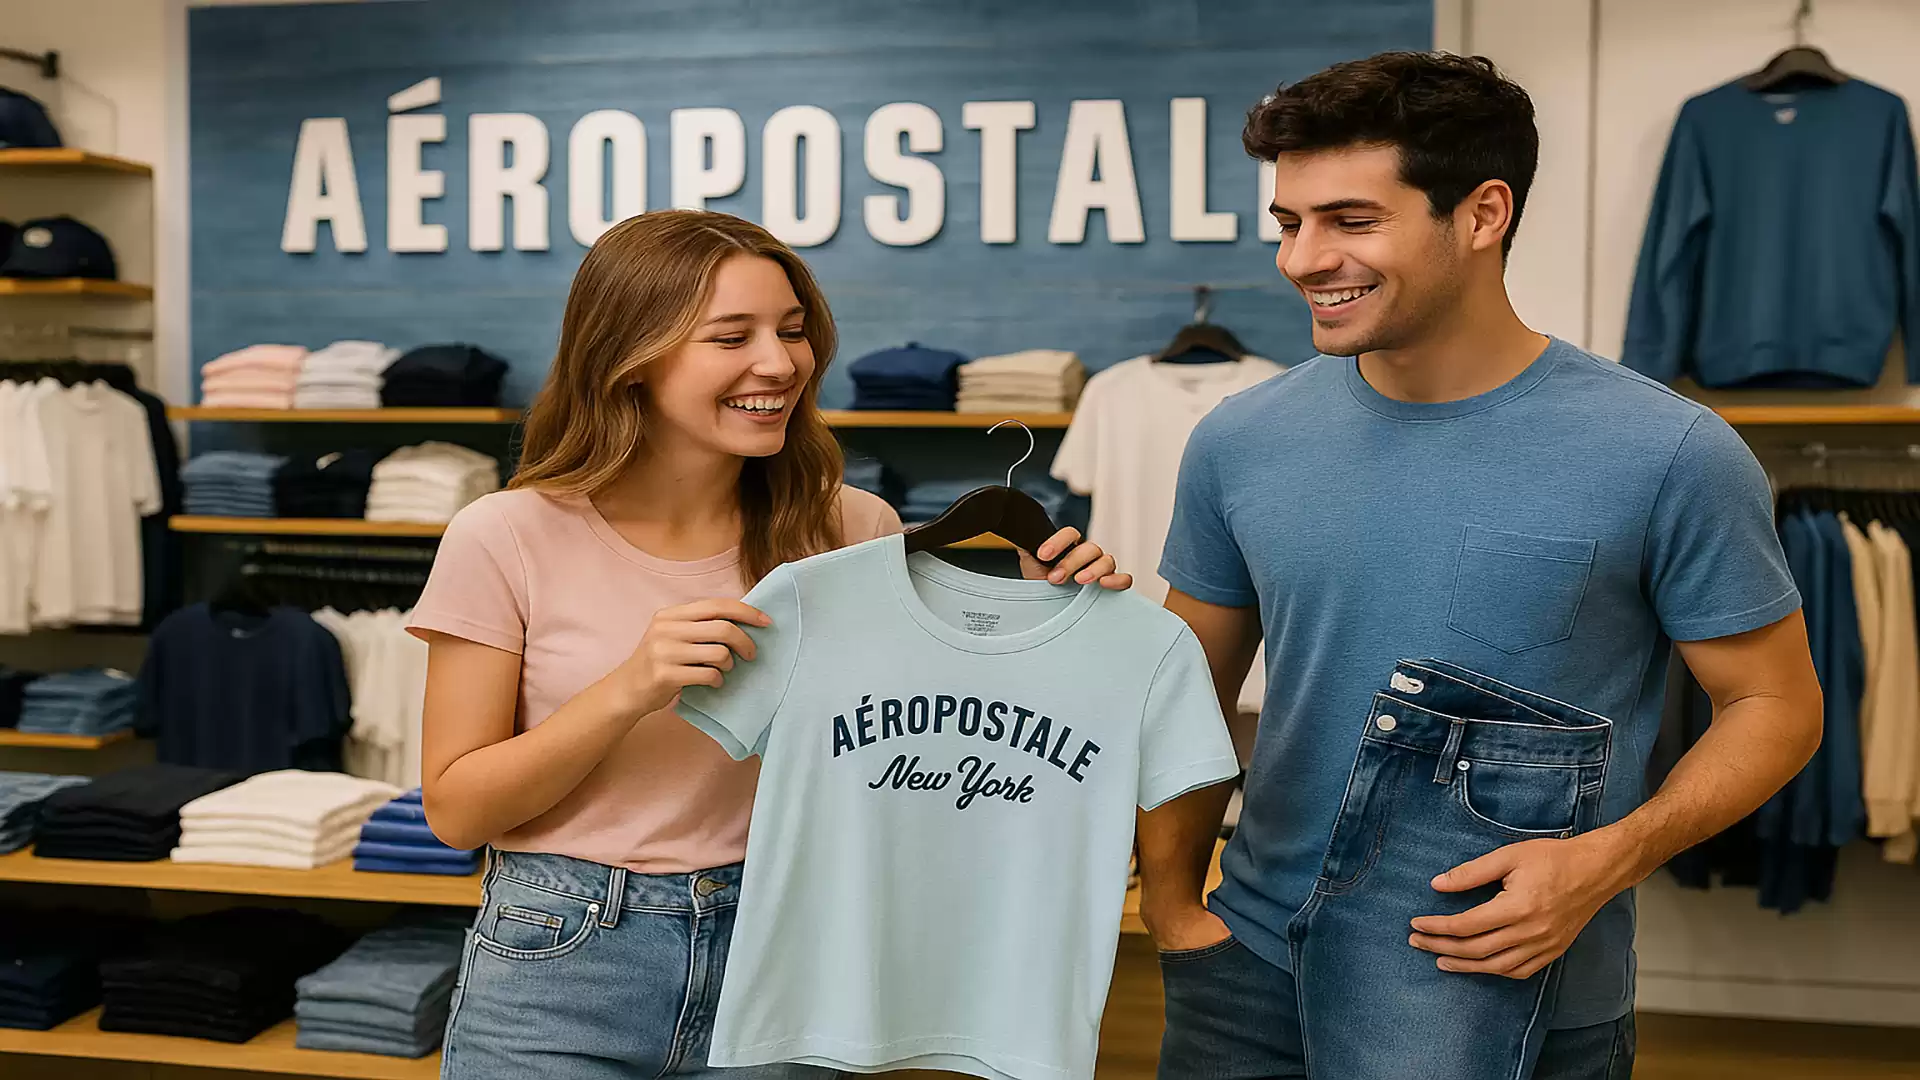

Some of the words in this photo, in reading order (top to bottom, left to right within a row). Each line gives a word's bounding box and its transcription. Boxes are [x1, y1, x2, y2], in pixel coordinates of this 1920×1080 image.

[281, 76, 1282, 253] AÉROPOSTAL
[832, 693, 1101, 784] AÉROPOSTALE
[868, 754, 952, 791] New
[955, 755, 1035, 811] York
